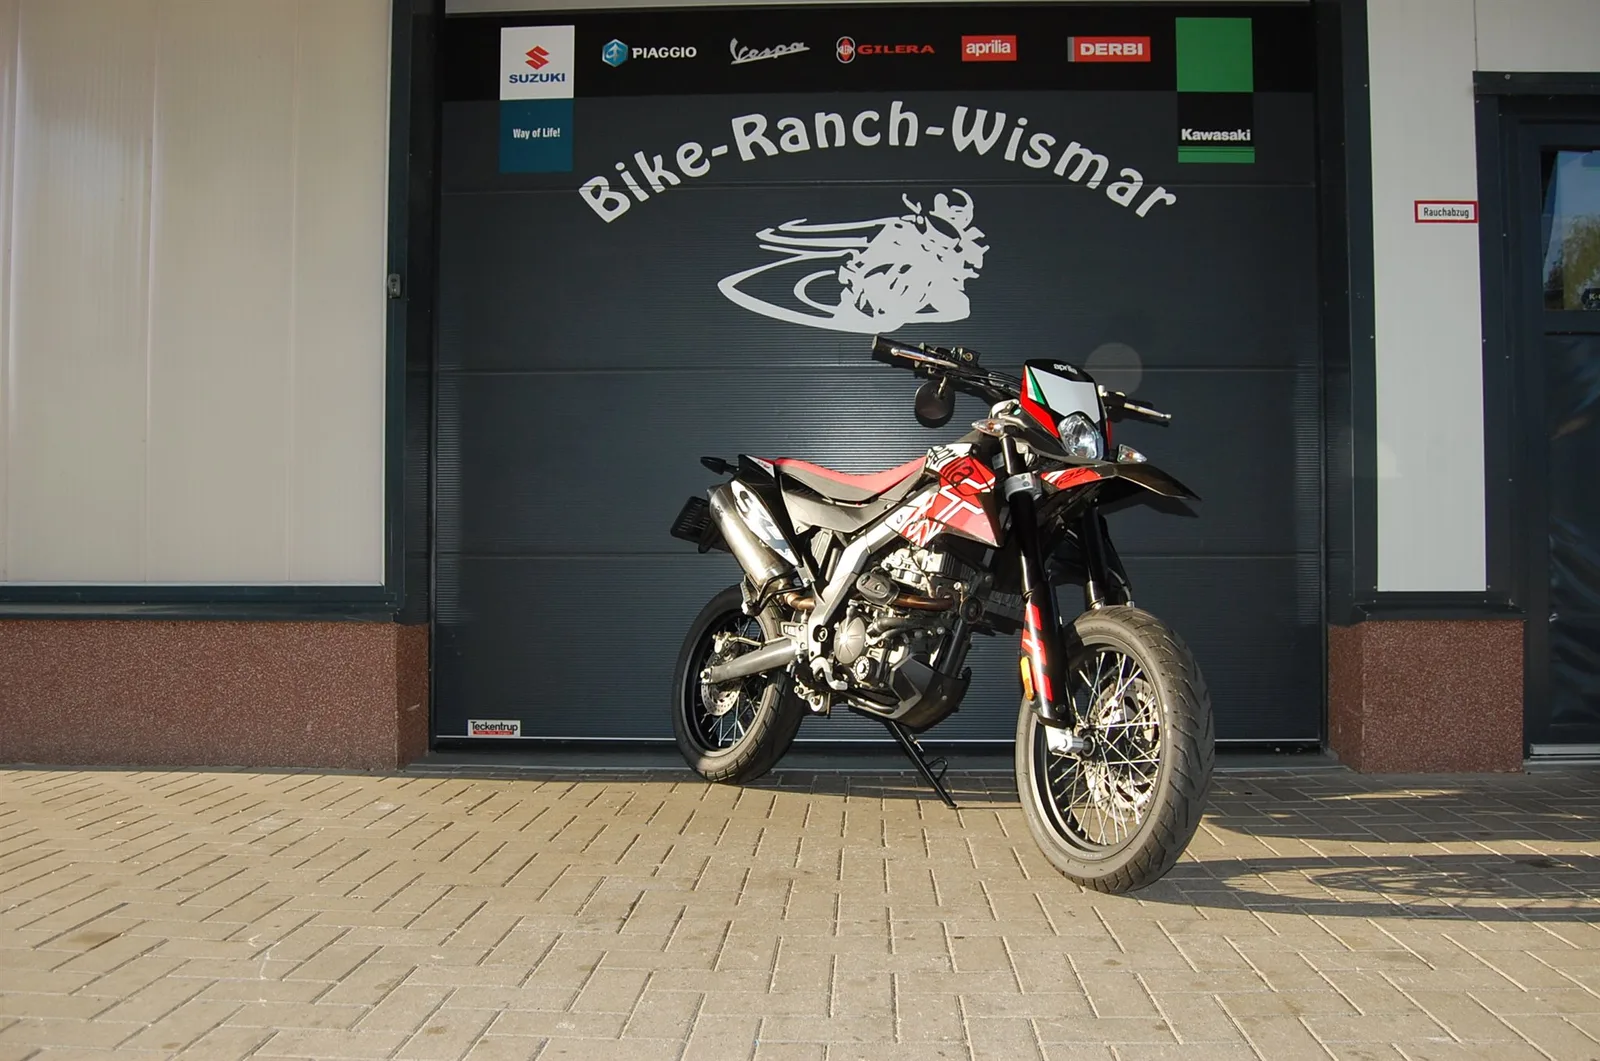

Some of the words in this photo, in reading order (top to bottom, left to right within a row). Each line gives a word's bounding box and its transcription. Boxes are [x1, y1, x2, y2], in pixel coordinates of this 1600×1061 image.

[632, 46, 697, 59] PIAGGIO
[730, 37, 811, 65] Vespa
[857, 44, 935, 55] GILERA
[966, 39, 1011, 56] aprilia
[1080, 43, 1143, 56] DERBI
[508, 73, 566, 84] SUZUKI
[513, 128, 529, 139] Way
[532, 128, 541, 138] of
[543, 127, 561, 138] Life!
[1181, 128, 1251, 141] Kawasaki
[1423, 207, 1470, 219] Rauchabzug
[470, 721, 518, 735] Teckentrup
